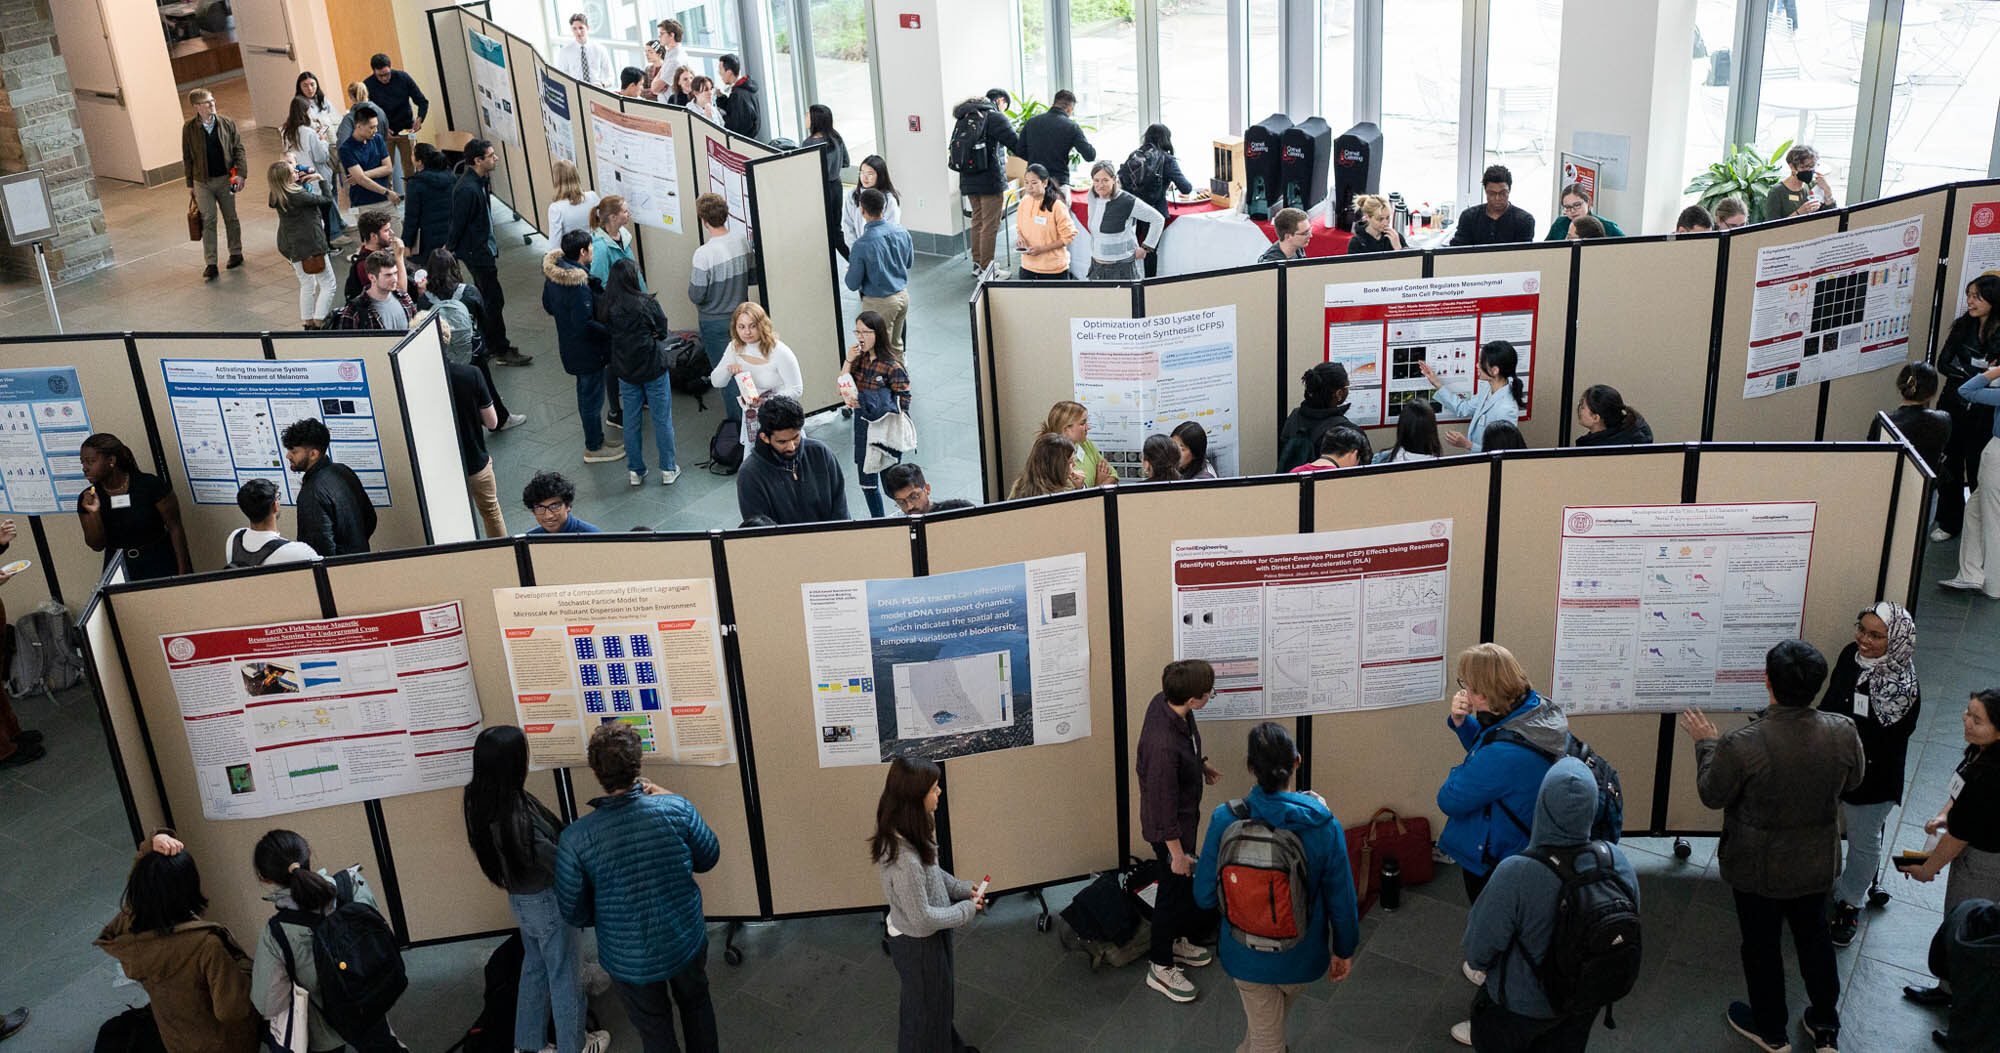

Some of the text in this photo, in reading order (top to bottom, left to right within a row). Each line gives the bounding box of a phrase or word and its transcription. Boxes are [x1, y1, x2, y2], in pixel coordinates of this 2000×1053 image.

[1430, 282, 1460, 290] Regulates
[1462, 279, 1503, 288] Mesenchymal
[1432, 289, 1464, 298] Phenotype
[1083, 311, 1215, 330] Optimization of S30 Lysate for
[1076, 321, 1224, 341] Cell-Free Protein Synthesis (CFPS)
[215, 366, 246, 374] Activating
[284, 366, 308, 374] System
[1269, 554, 1323, 563] Carrier-Envelope
[1346, 550, 1364, 558] (CEP)
[1390, 546, 1408, 554] Using
[1409, 542, 1444, 550] Resonance
[1311, 560, 1352, 568] Acceleration
[515, 592, 556, 600] Development
[573, 588, 625, 597] Computationally
[626, 586, 652, 594] Efficient
[653, 585, 690, 593] Lagrangian
[513, 608, 547, 617] Microscale
[560, 607, 588, 615] Pollutant
[590, 605, 623, 614] Dispersion
[633, 604, 653, 612] Urban
[655, 602, 696, 611] Environment
[558, 598, 589, 607] Stochastic
[881, 610, 906, 619] model
[908, 608, 934, 618] eDNA
[935, 603, 974, 614] transport
[265, 627, 288, 635] Earth's
[331, 620, 359, 628] Magnetic
[888, 610, 1010, 632] which indicates the spatial and
[248, 636, 280, 644] Resonance
[318, 628, 359, 637] Underground
[880, 636, 916, 646] temporal
[918, 632, 957, 642] variations
